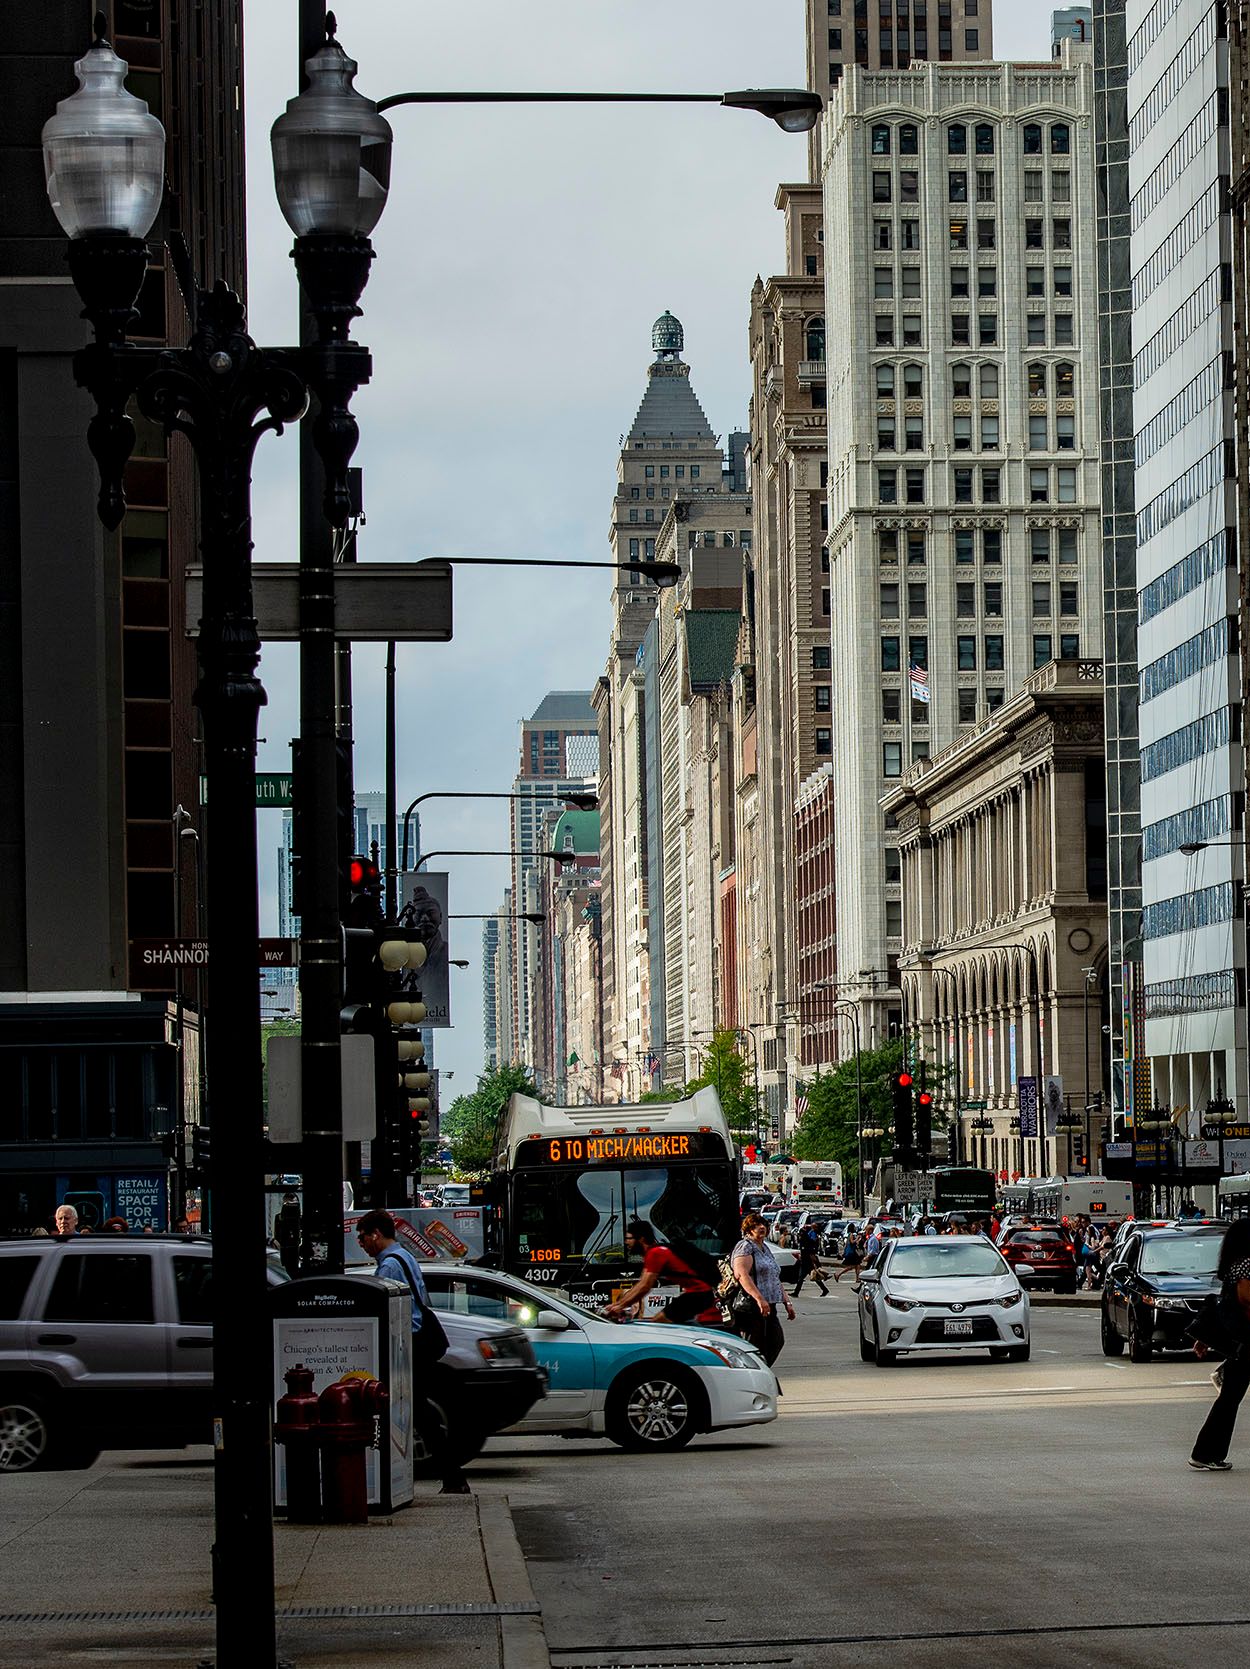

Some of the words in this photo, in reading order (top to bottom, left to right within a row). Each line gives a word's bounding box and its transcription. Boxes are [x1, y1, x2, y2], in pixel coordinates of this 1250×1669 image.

[256, 781, 275, 798] uth
[264, 951, 284, 961] WAY
[425, 1006, 446, 1017] ield
[1020, 1088, 1028, 1132] TERRACOTTA
[1028, 1085, 1037, 1136] WARRIORS
[550, 1140, 560, 1161] 6
[565, 1140, 582, 1160] TO
[587, 1135, 689, 1159] MICH/WACKER
[118, 1179, 159, 1188] RETAIL/
[118, 1195, 158, 1206] SPACE
[126, 1206, 152, 1217] FOR
[128, 1217, 159, 1229] EASE
[519, 1244, 530, 1254] 03
[529, 1248, 561, 1262] 1606
[525, 1268, 559, 1281] 4307
[572, 1293, 609, 1303] People's
[283, 1344, 324, 1355] Chicago's
[324, 1344, 348, 1353] tallest
[350, 1344, 369, 1353] tales
[305, 1355, 338, 1364] revealed
